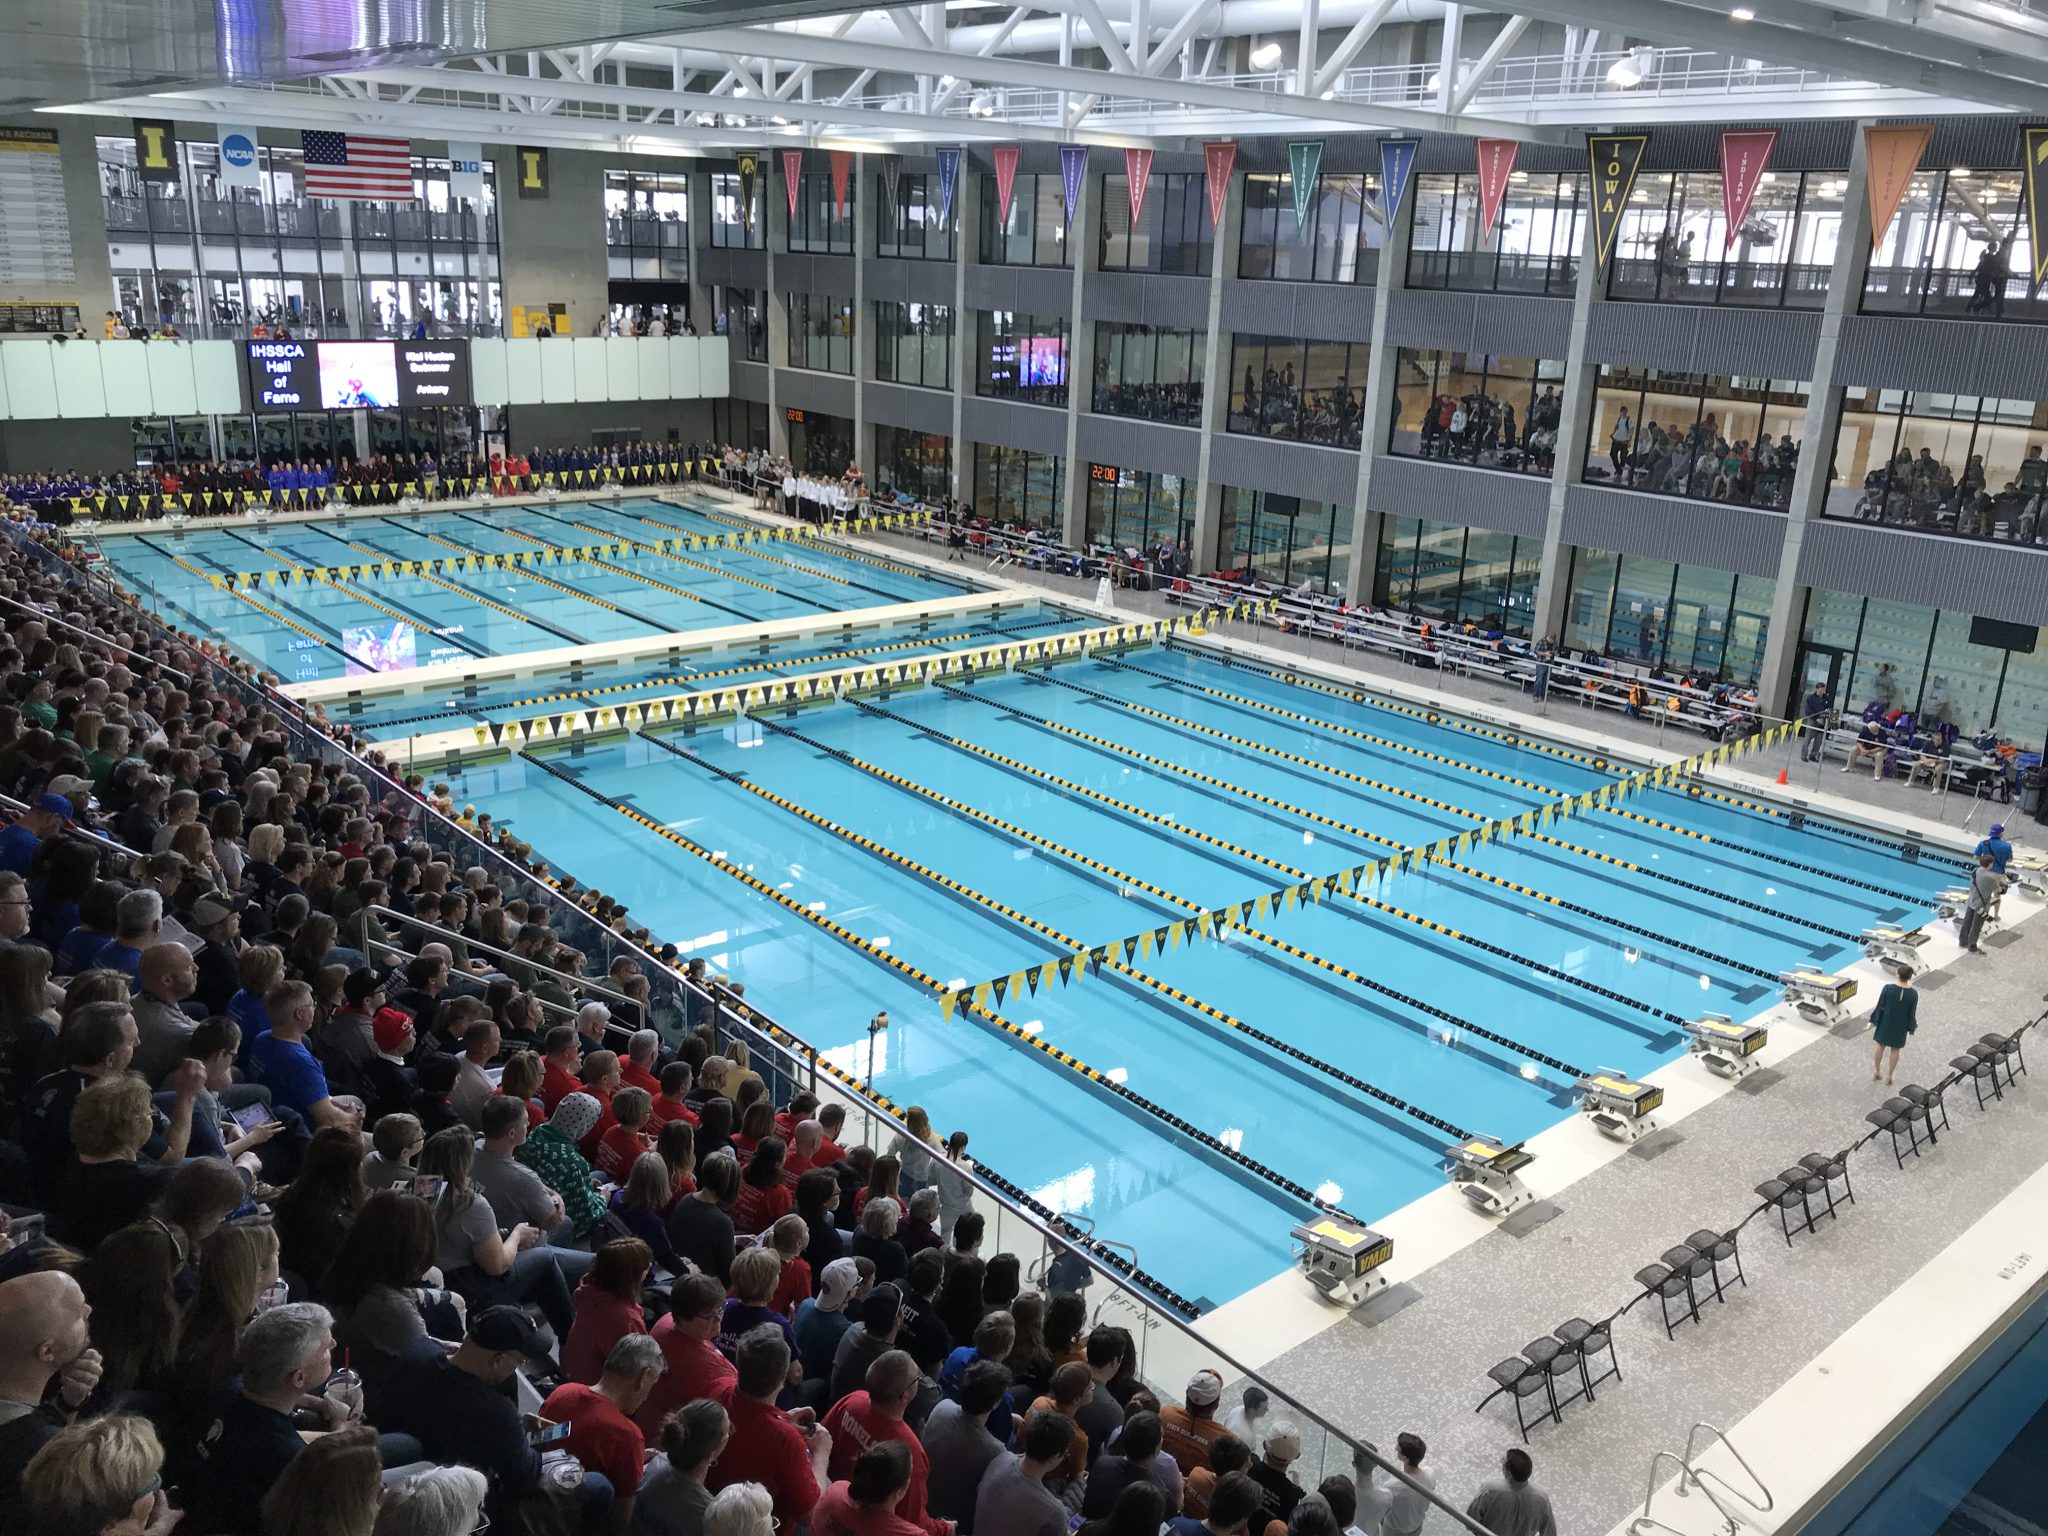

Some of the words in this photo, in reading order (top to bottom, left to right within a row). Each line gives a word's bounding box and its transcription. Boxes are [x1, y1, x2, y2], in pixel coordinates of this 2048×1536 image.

[226, 149, 254, 160] NCAA
[1134, 149, 1142, 201] NEBRASKA
[1391, 148, 1402, 198] MICHIGAN
[1489, 145, 1501, 197] MARYLAND
[1735, 151, 1748, 202] INDIANA
[1884, 139, 1900, 201] ILLINOIS
[1602, 143, 1621, 213] IOWA
[251, 343, 305, 358] IHSSCA
[266, 360, 292, 374] Hall
[273, 376, 288, 388] of
[263, 391, 301, 405] Fame
[1092, 464, 1116, 481] 22:00
[1186, 922, 1194, 935] 7
[1029, 971, 1038, 985] 8
[1717, 1047, 1723, 1055] 5
[1482, 1176, 1488, 1184] 7
[1360, 1243, 1393, 1273] IOWA
[1328, 1261, 1337, 1271] 8
